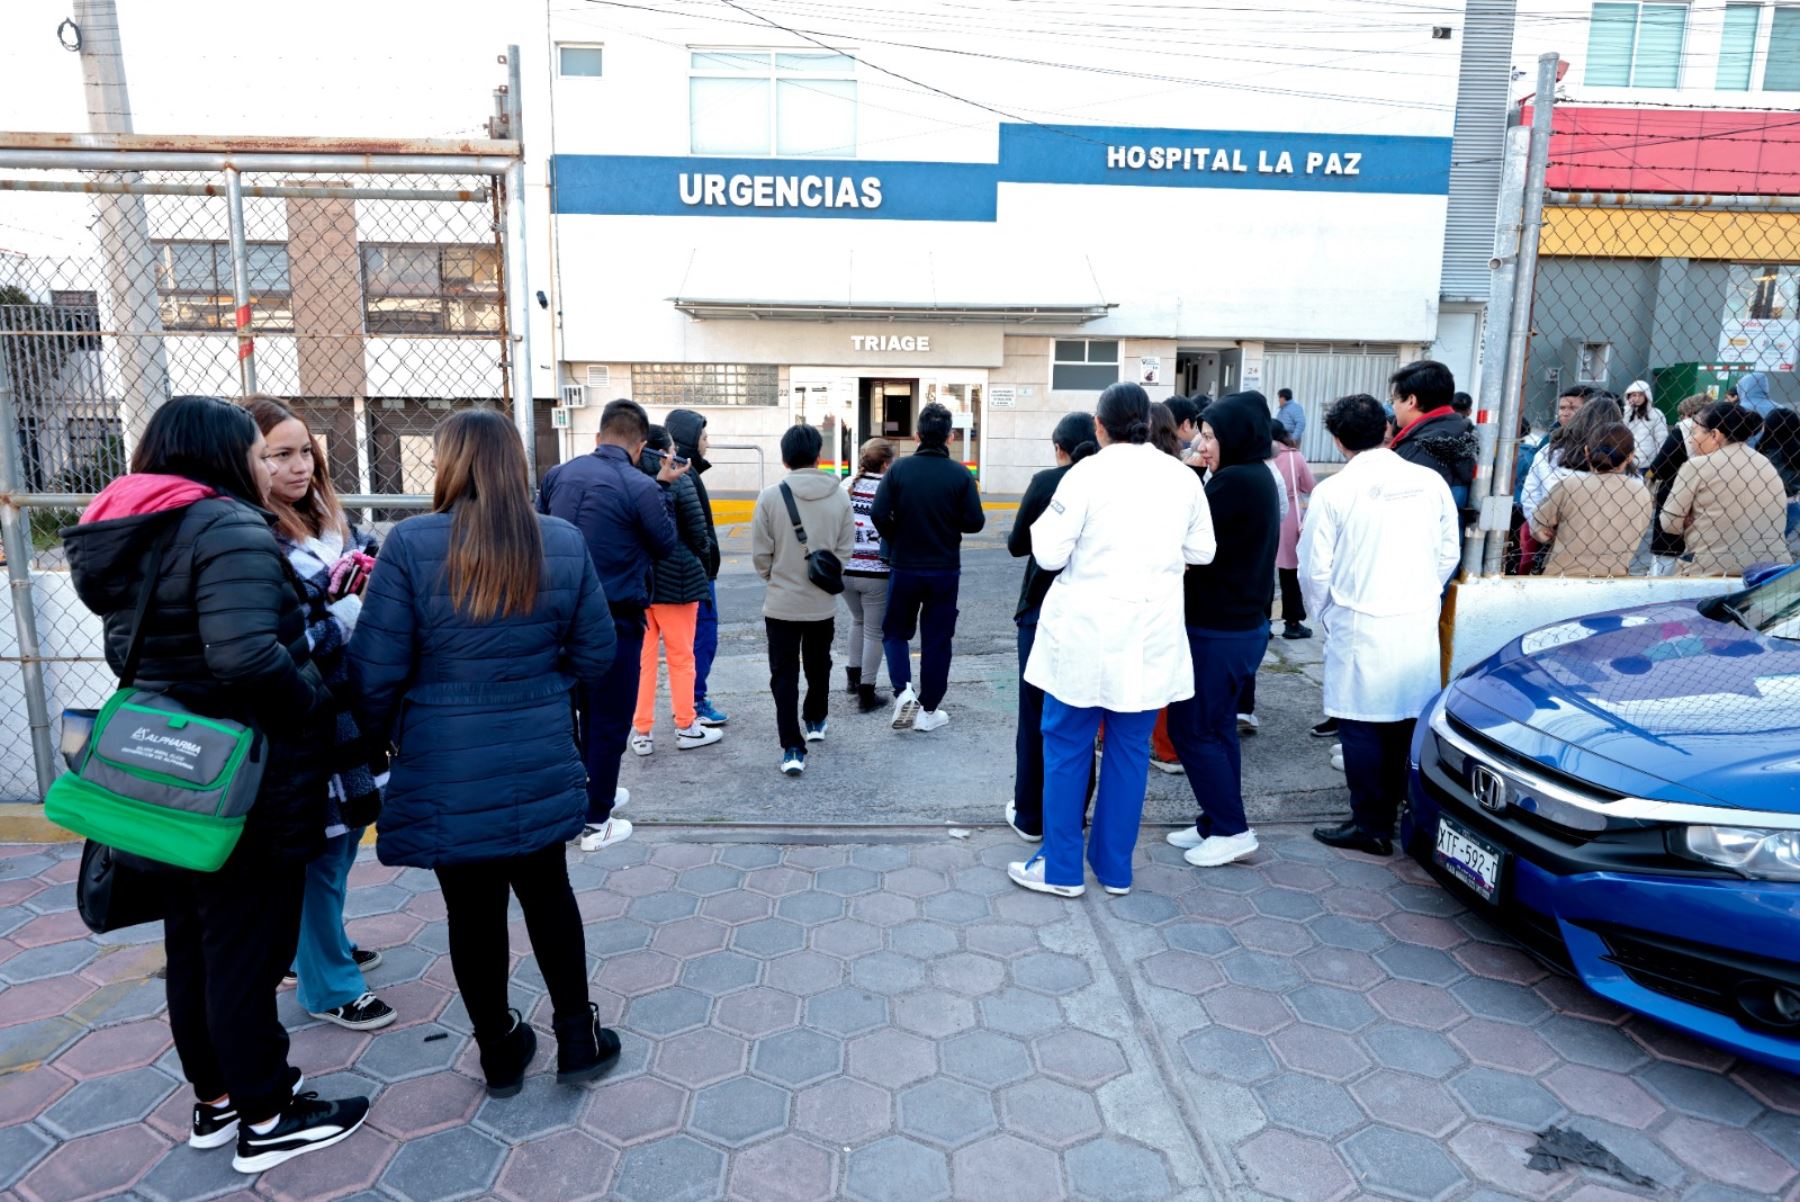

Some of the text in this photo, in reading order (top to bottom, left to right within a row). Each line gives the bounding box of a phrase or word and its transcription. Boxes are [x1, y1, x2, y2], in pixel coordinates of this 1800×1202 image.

[1106, 145, 1362, 175] HOSPITAL LA PAZ
[679, 173, 882, 208] URGENCIAS
[851, 335, 930, 351] TRIAGE
[145, 734, 201, 755] ALPHARMA
